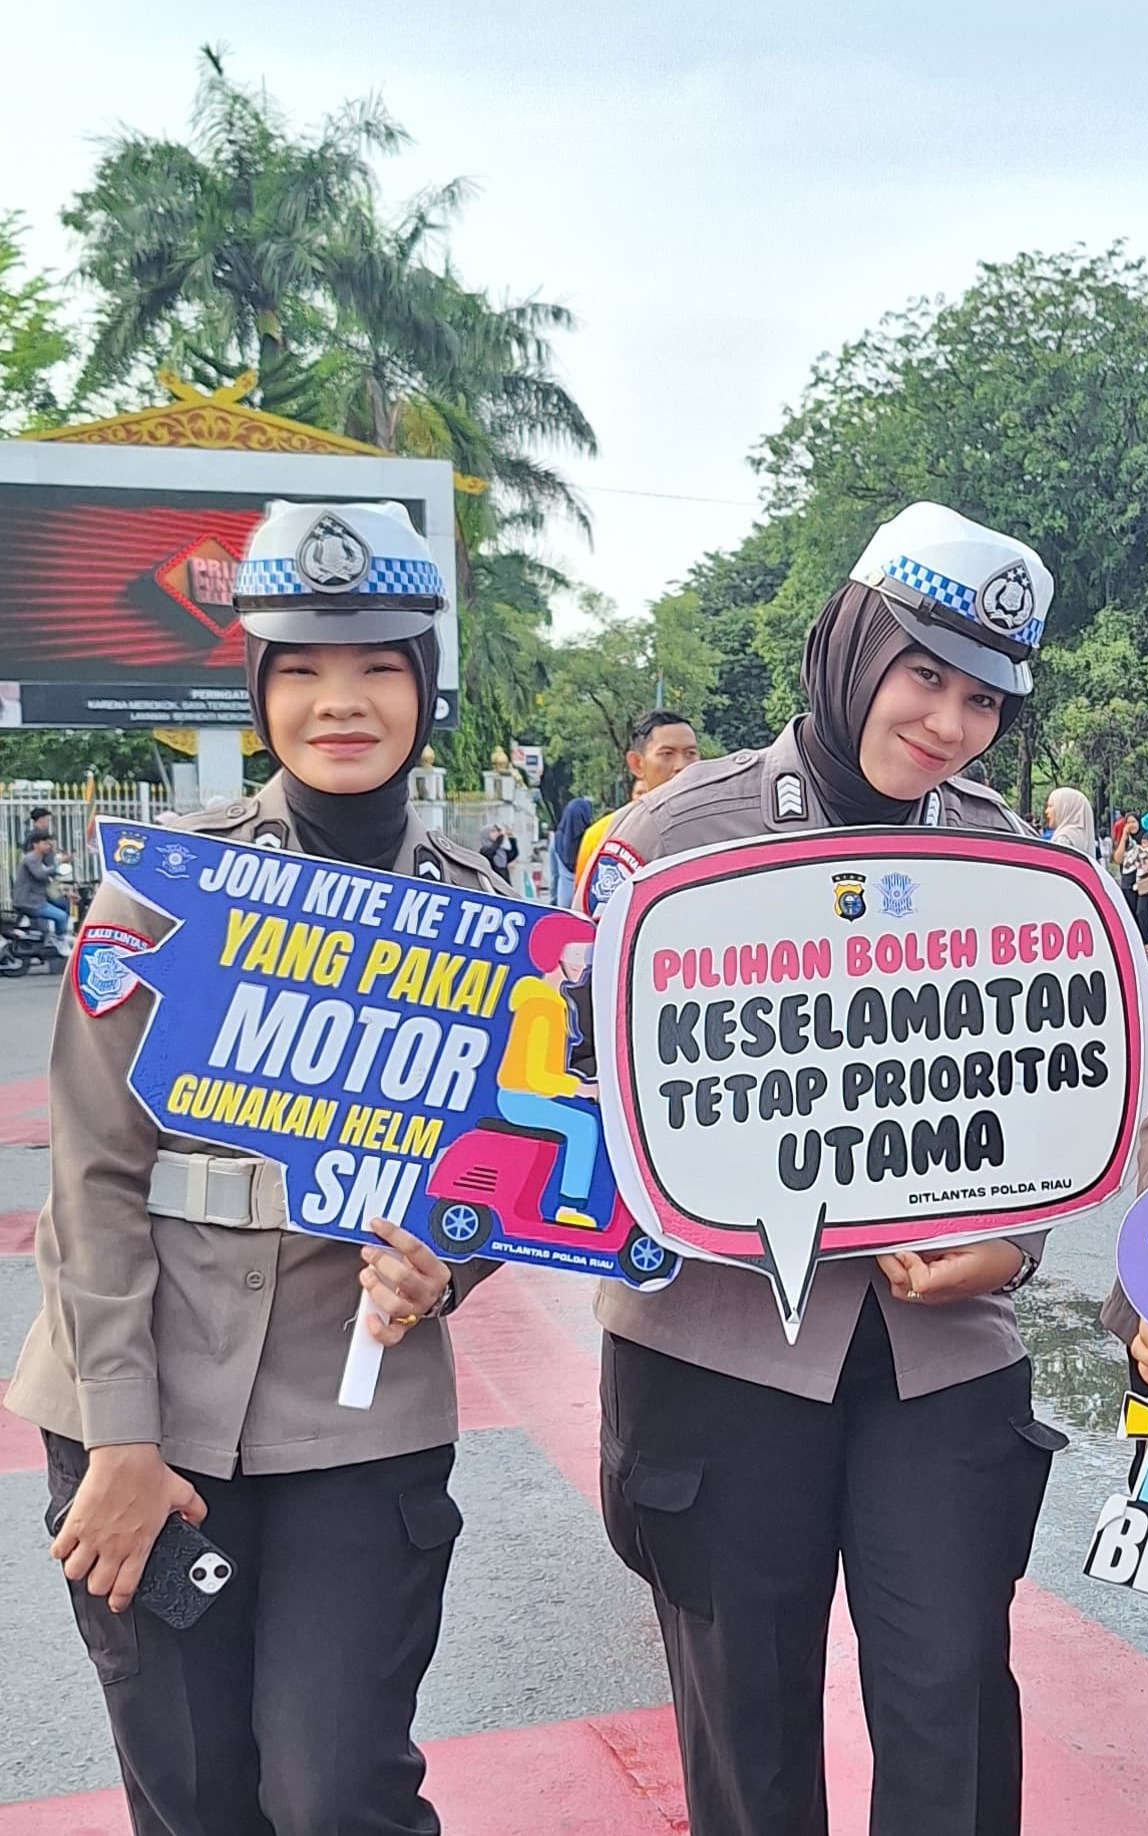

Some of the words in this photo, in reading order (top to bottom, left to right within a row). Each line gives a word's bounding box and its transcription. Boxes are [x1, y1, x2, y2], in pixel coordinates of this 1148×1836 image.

[191, 557, 234, 579] PRI
[190, 688, 250, 699] PERINGATA
[200, 848, 302, 908] JOM
[302, 869, 396, 929] KITE
[396, 886, 451, 939] KE
[453, 900, 525, 953] TPS
[219, 908, 354, 986] YANG
[359, 940, 508, 1018] PAKAI
[653, 937, 832, 992] PILIHAN
[846, 927, 977, 977] BOLEH
[991, 919, 1093, 963] BEDA
[208, 982, 491, 1111] MOTOR
[658, 970, 1107, 1065] KESELAMATAN
[167, 1074, 338, 1139] GUNAKAN
[340, 1106, 444, 1158] HELM
[660, 1066, 827, 1129] TETAP
[842, 1040, 1109, 1112] PRIORITAS
[301, 1148, 421, 1231] SNI
[778, 1109, 1004, 1191] UTAMA
[908, 1186, 986, 1205] DITLANTAS
[991, 1181, 1036, 1197] POLDA
[1040, 1178, 1072, 1192] RIAU
[492, 1241, 550, 1258] DITLANTAS
[552, 1252, 587, 1265] POLDA
[589, 1258, 614, 1270] RIAU
